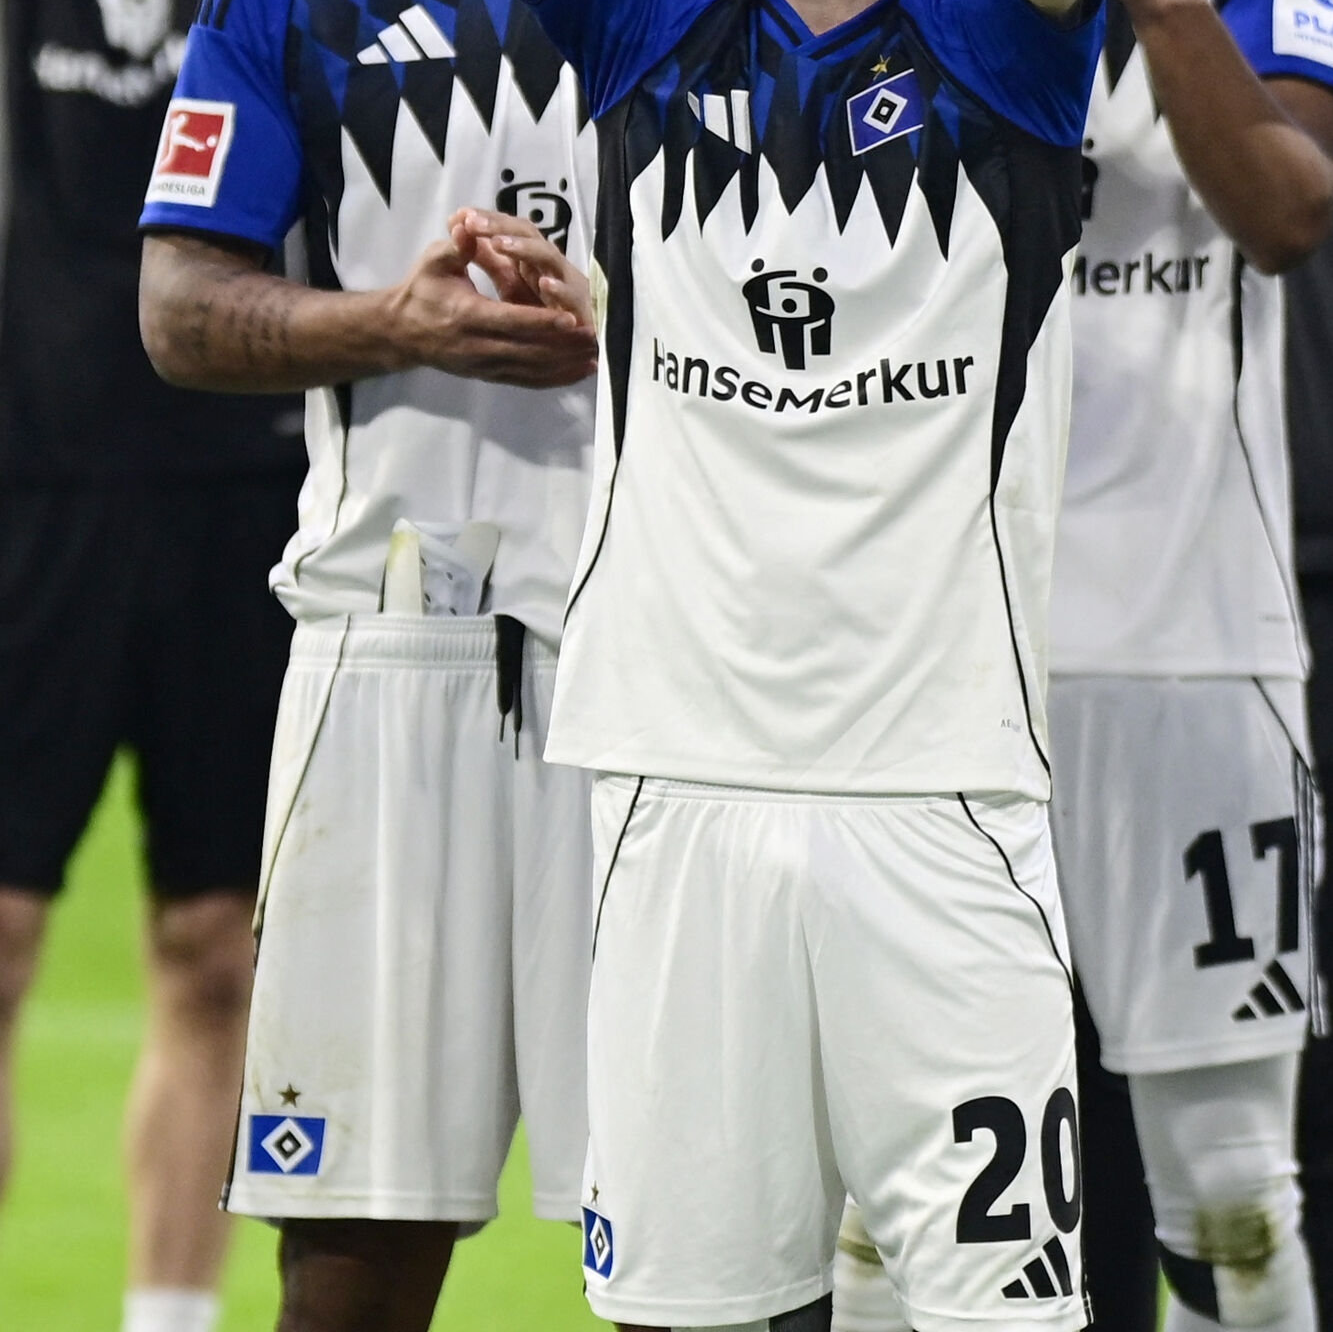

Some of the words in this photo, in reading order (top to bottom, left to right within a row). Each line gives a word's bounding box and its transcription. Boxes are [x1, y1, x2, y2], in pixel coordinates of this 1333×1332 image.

[652, 337, 975, 414] HanseMerkur
[1182, 816, 1300, 970] 17
[952, 1086, 1081, 1245] 20
